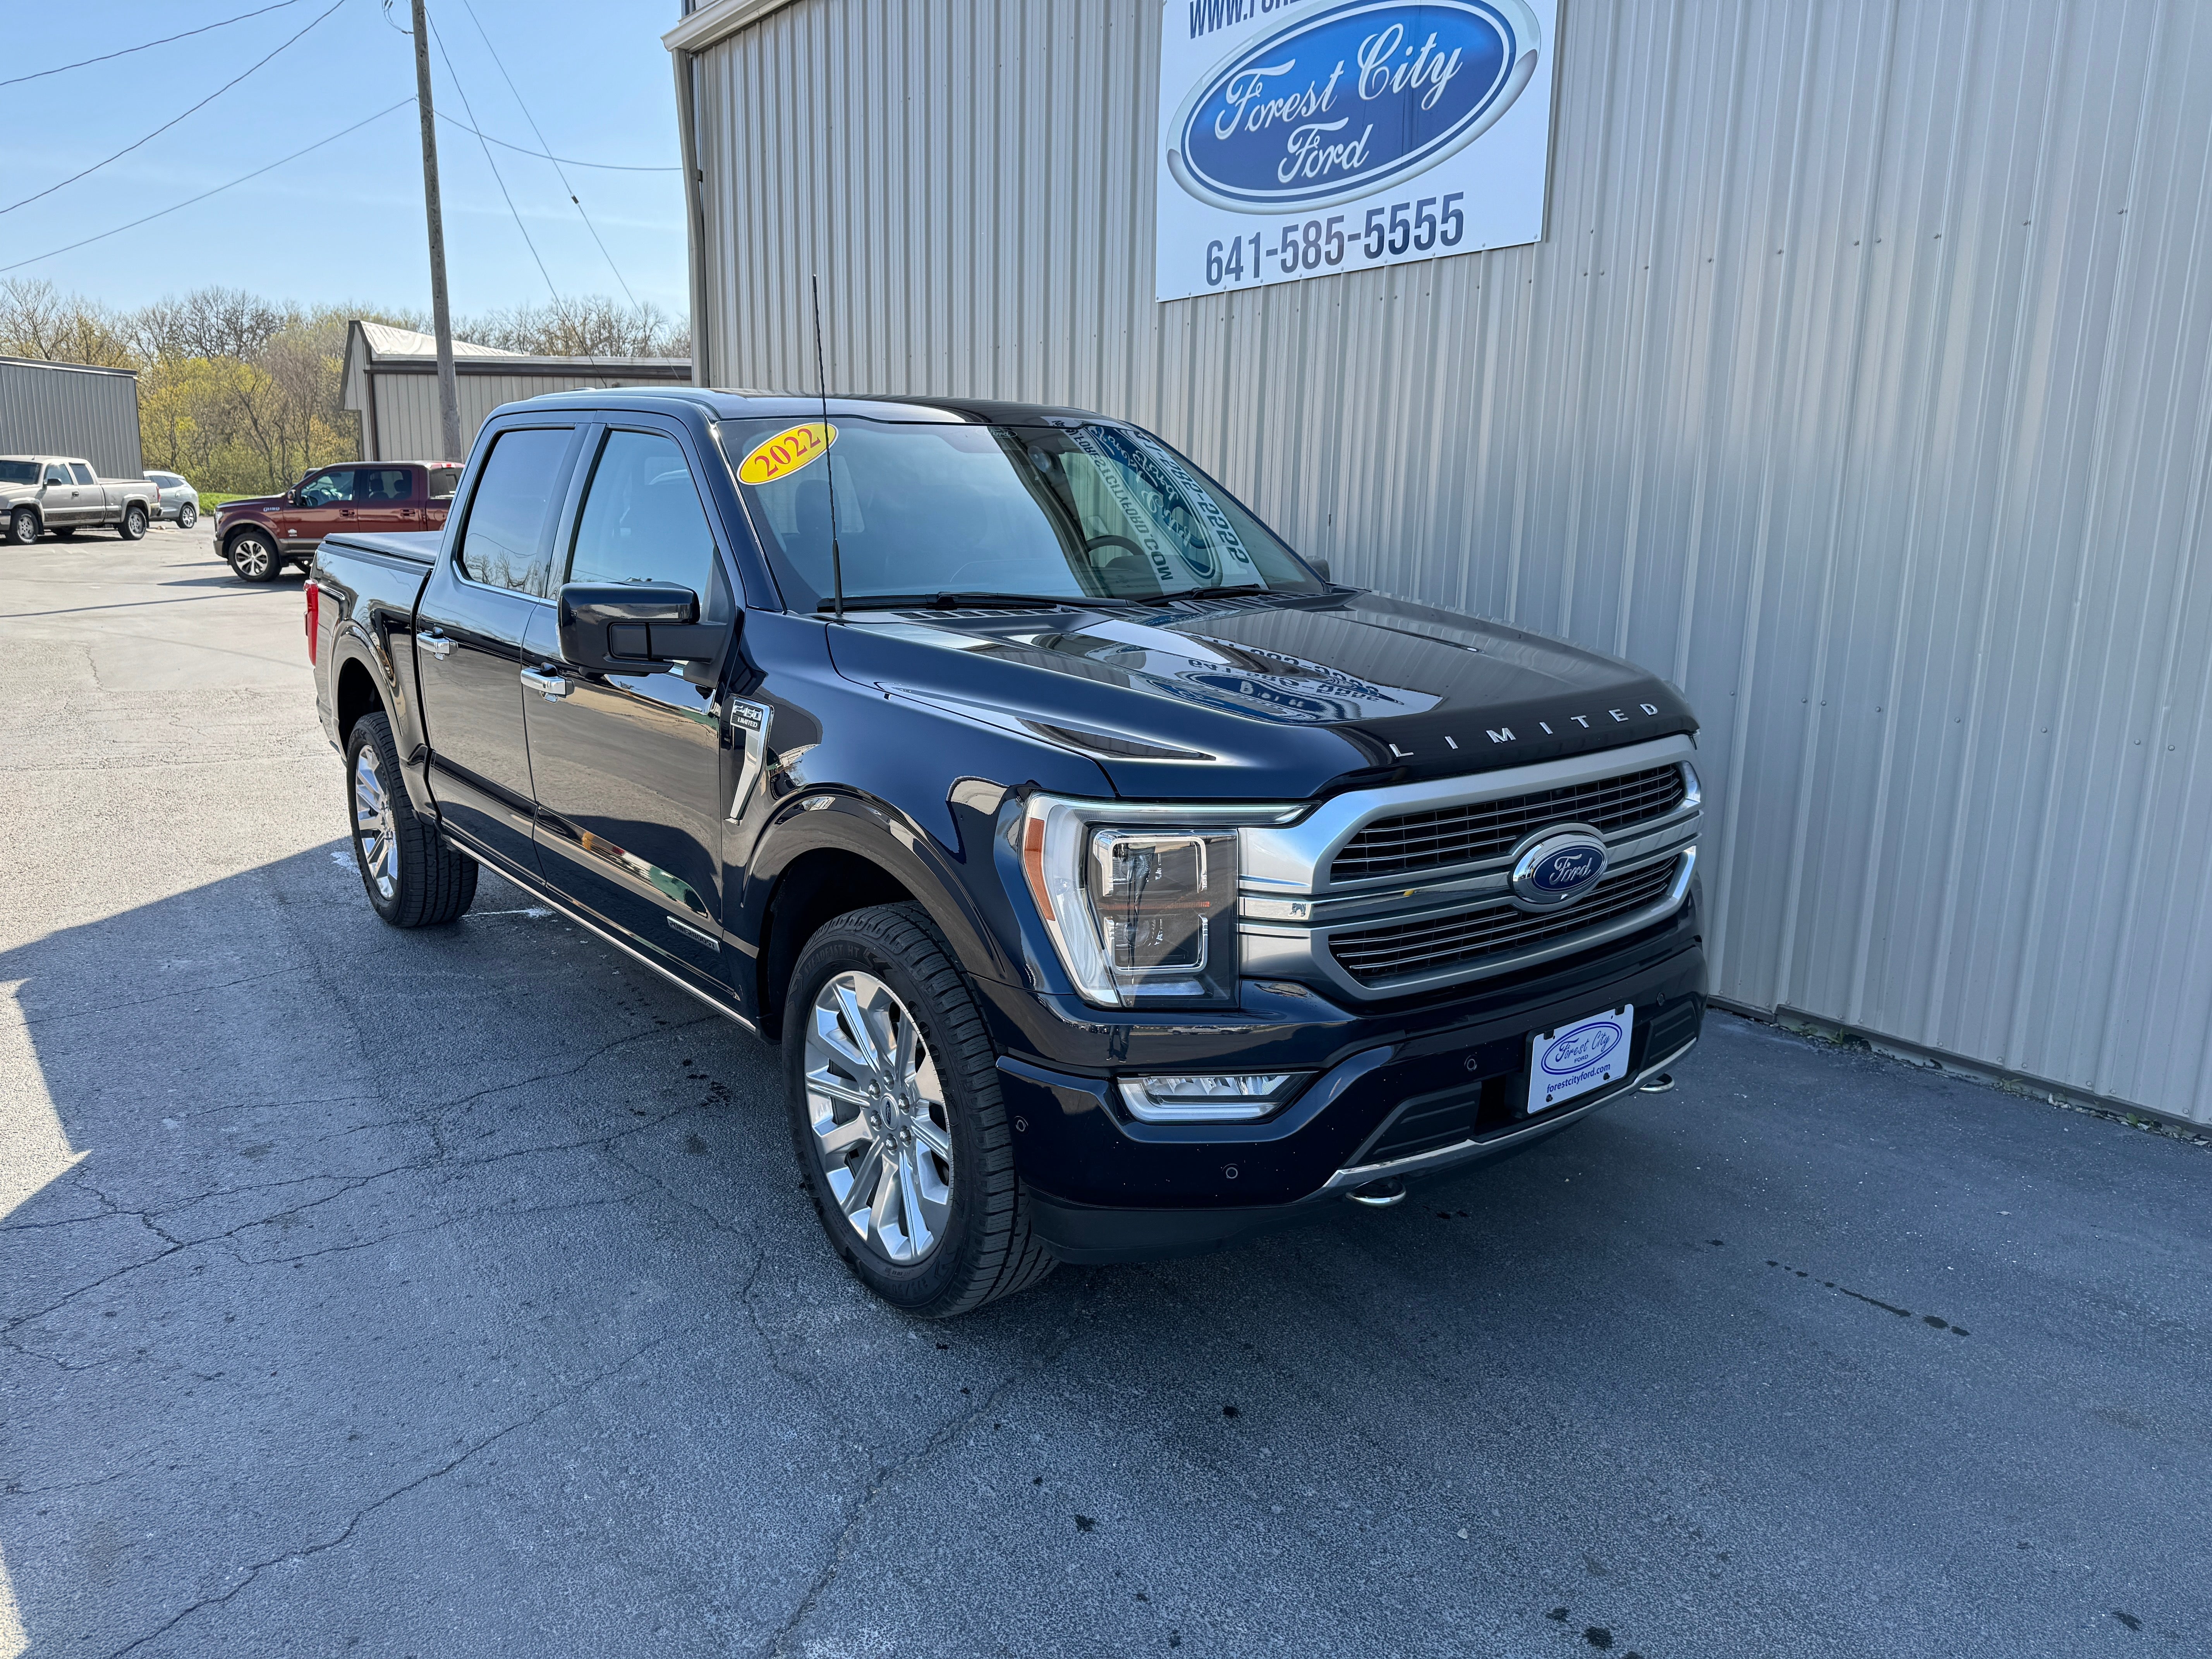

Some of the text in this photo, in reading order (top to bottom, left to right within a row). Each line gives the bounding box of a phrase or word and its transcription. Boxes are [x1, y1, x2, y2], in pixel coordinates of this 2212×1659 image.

[1215, 23, 1462, 140] Forest City
[1278, 117, 1373, 184] Ford
[1206, 191, 1464, 286] 641-585-5555
[754, 428, 821, 477] 2022
[737, 717, 758, 728] LIMITED
[1389, 703, 1658, 758] LIMITED
[1549, 854, 1593, 885] Ford
[804, 944, 860, 976] STEADFAST HT
[1555, 1030, 1610, 1062] Forest City
[1574, 1054, 1589, 1063] FORD
[1546, 1063, 1611, 1093] forestcityford.com
